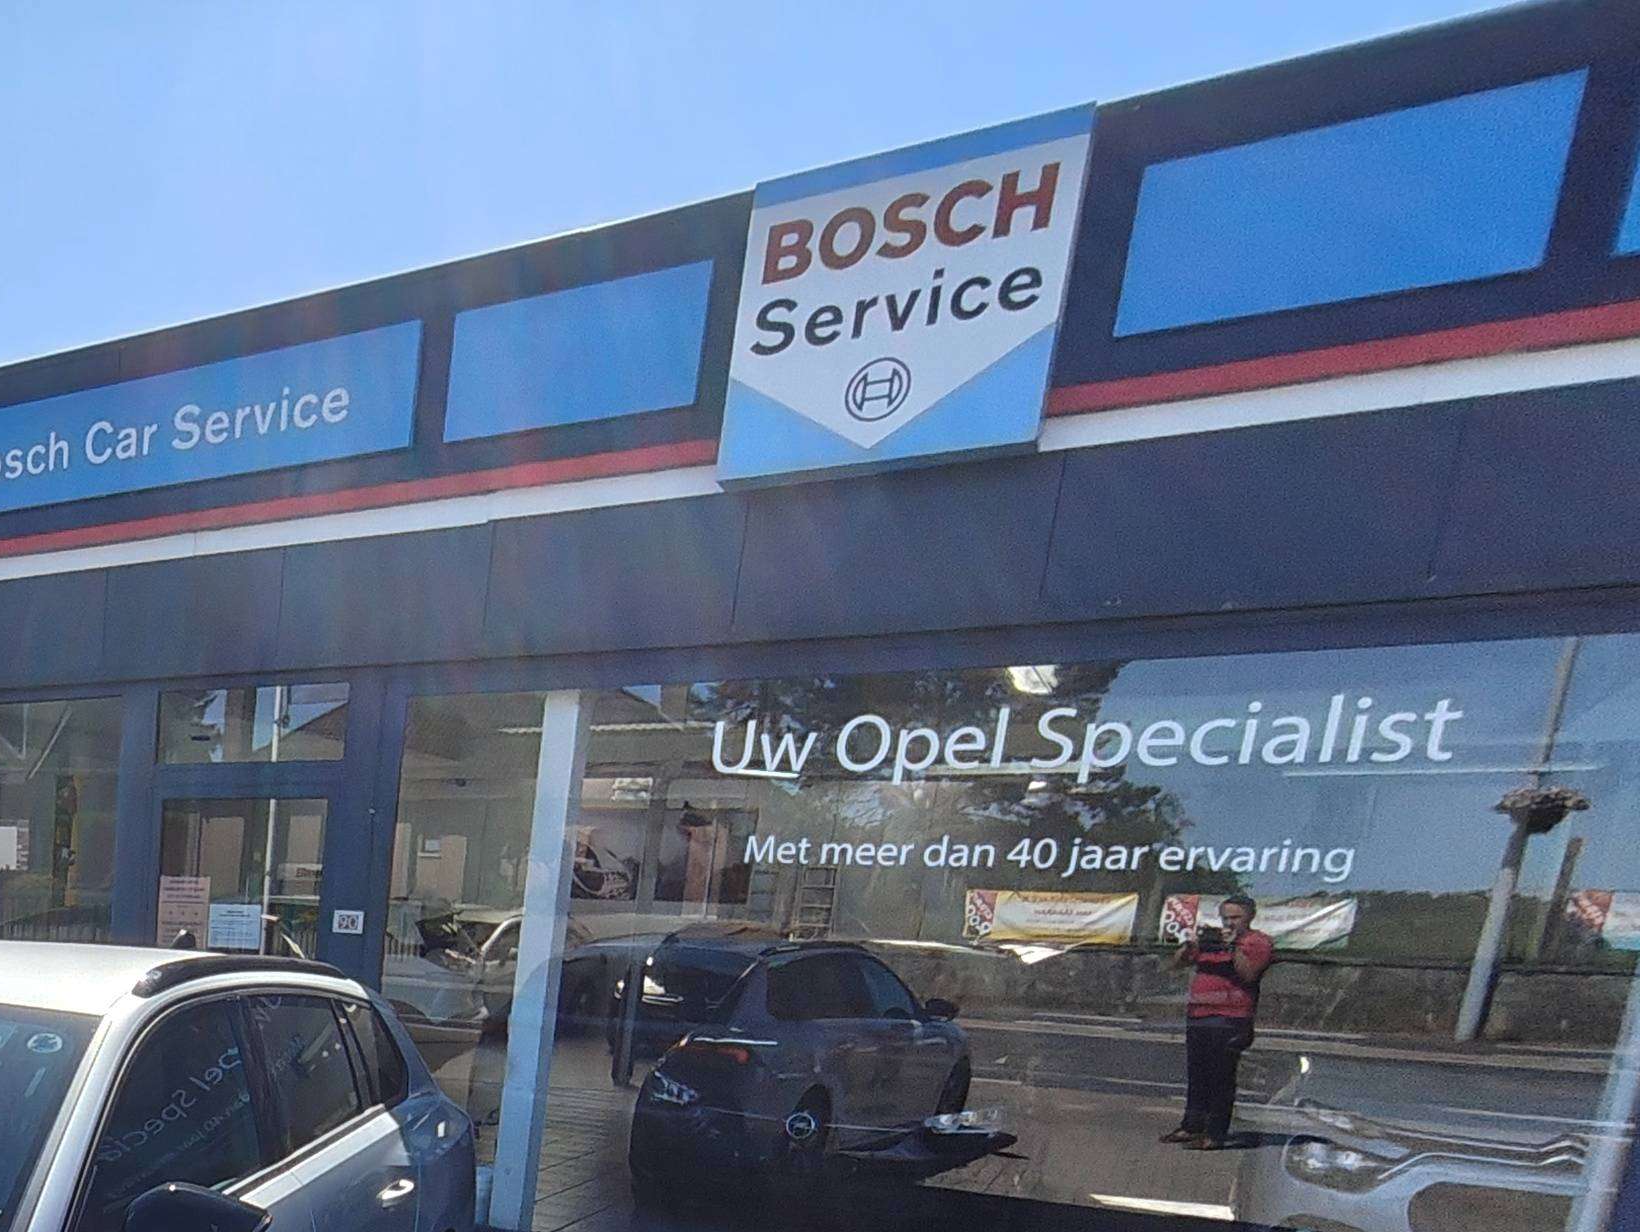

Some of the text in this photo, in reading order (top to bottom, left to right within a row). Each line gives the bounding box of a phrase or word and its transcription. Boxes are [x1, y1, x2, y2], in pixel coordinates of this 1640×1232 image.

[762, 161, 1061, 285] BOSCH
[750, 267, 1043, 357] Service
[85, 420, 159, 465] Car
[171, 385, 350, 450] Service
[711, 694, 1464, 785] Uw Opel Specialist
[743, 834, 1356, 883] Met meer dan 40 jaar ervaring
